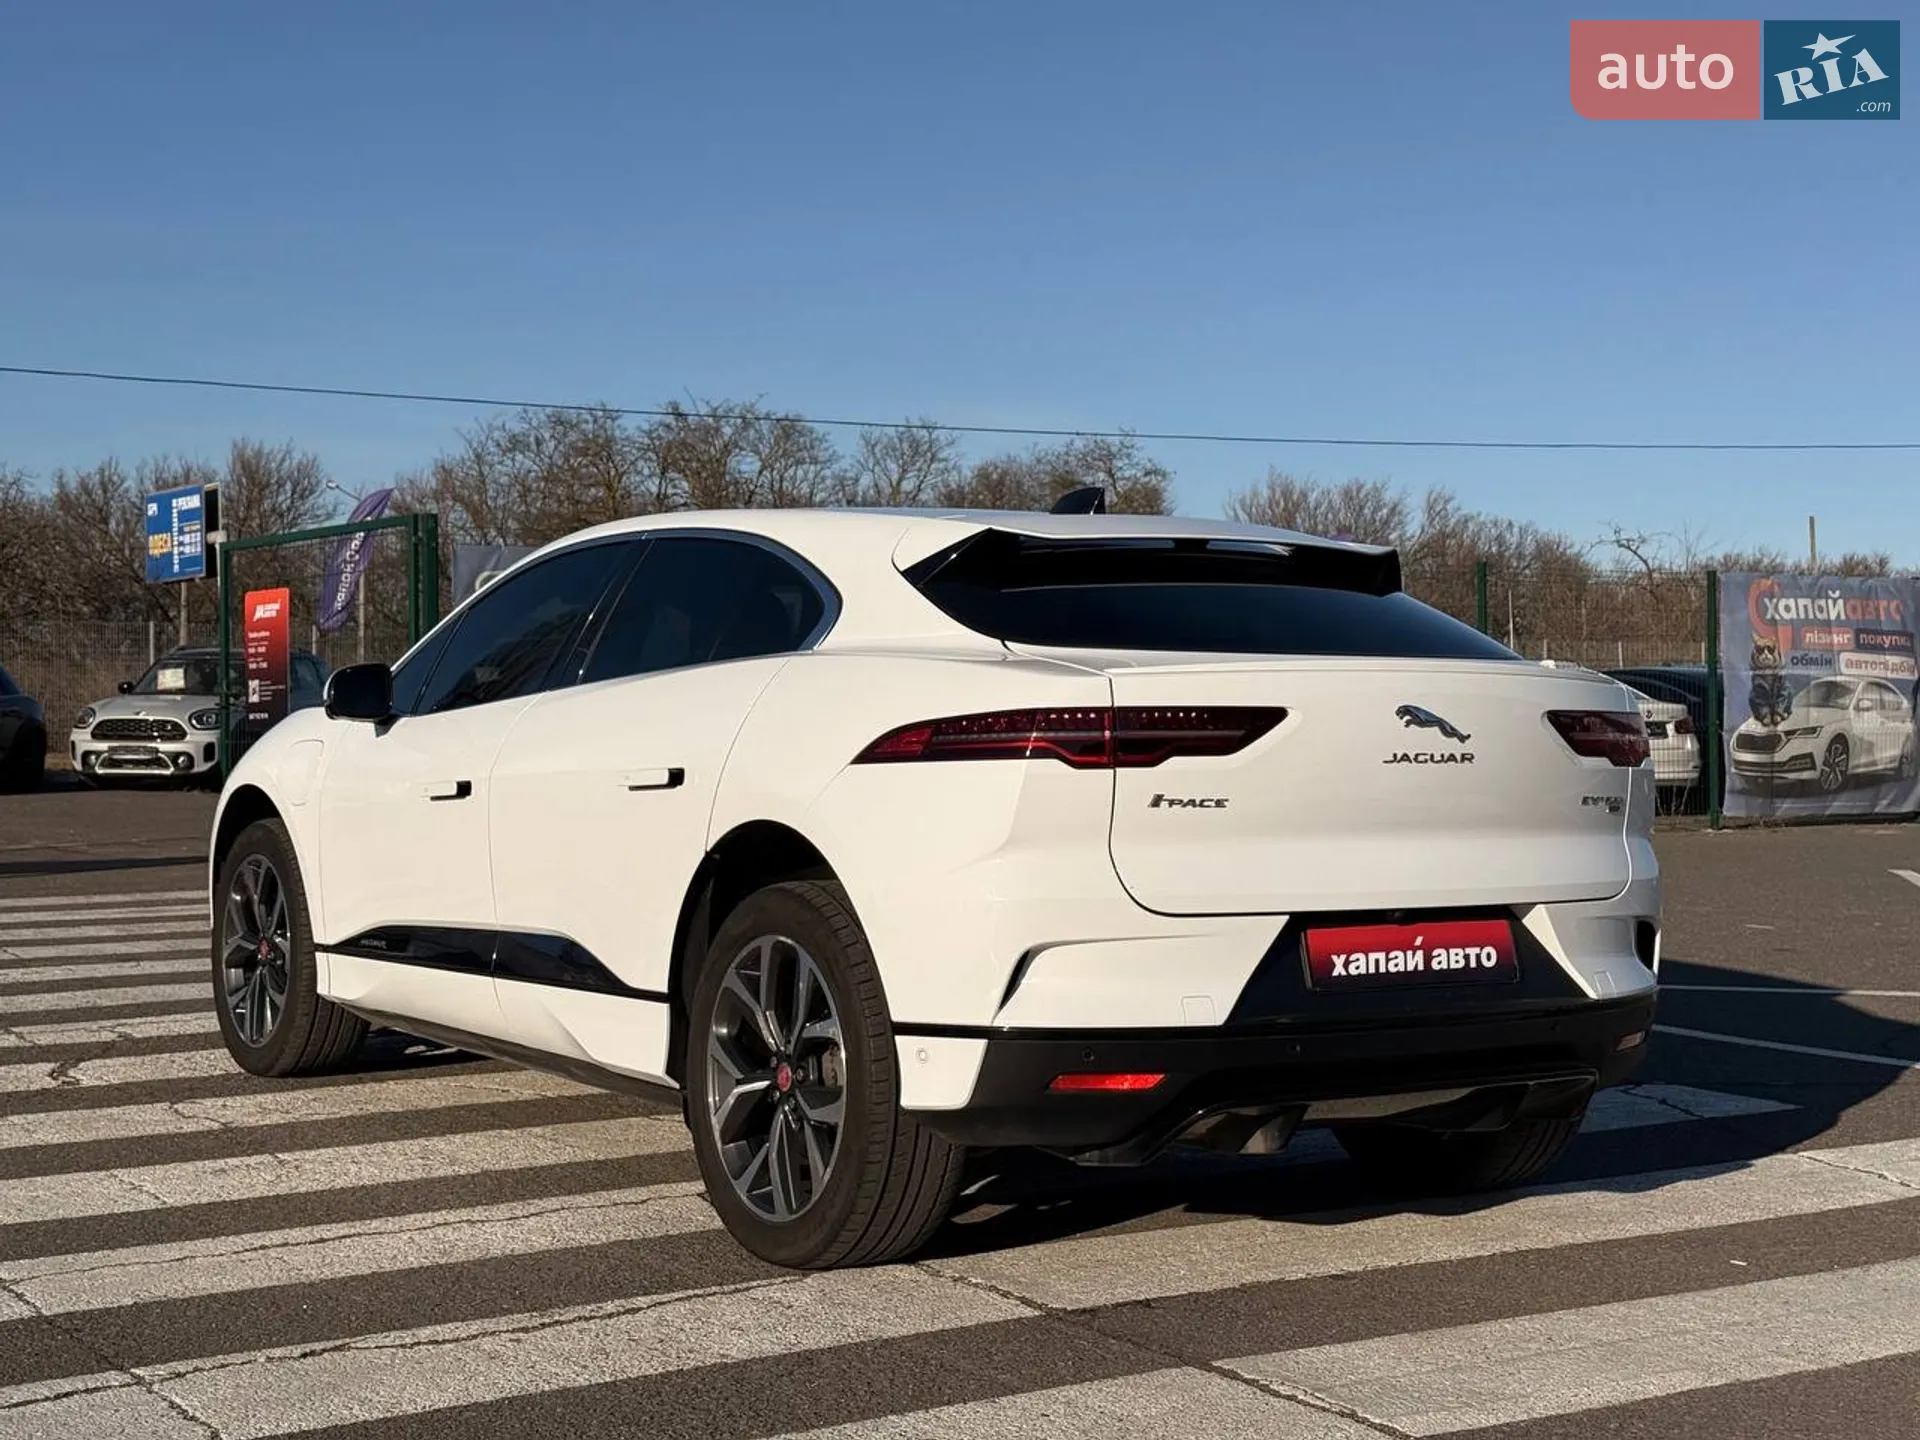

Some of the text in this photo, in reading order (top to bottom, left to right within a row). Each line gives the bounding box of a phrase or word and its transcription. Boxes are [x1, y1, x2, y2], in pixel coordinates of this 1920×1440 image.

[1791, 653, 1832, 667] обмін
[1382, 752, 1475, 765] JAGUAR
[1431, 946, 1498, 970] авто
